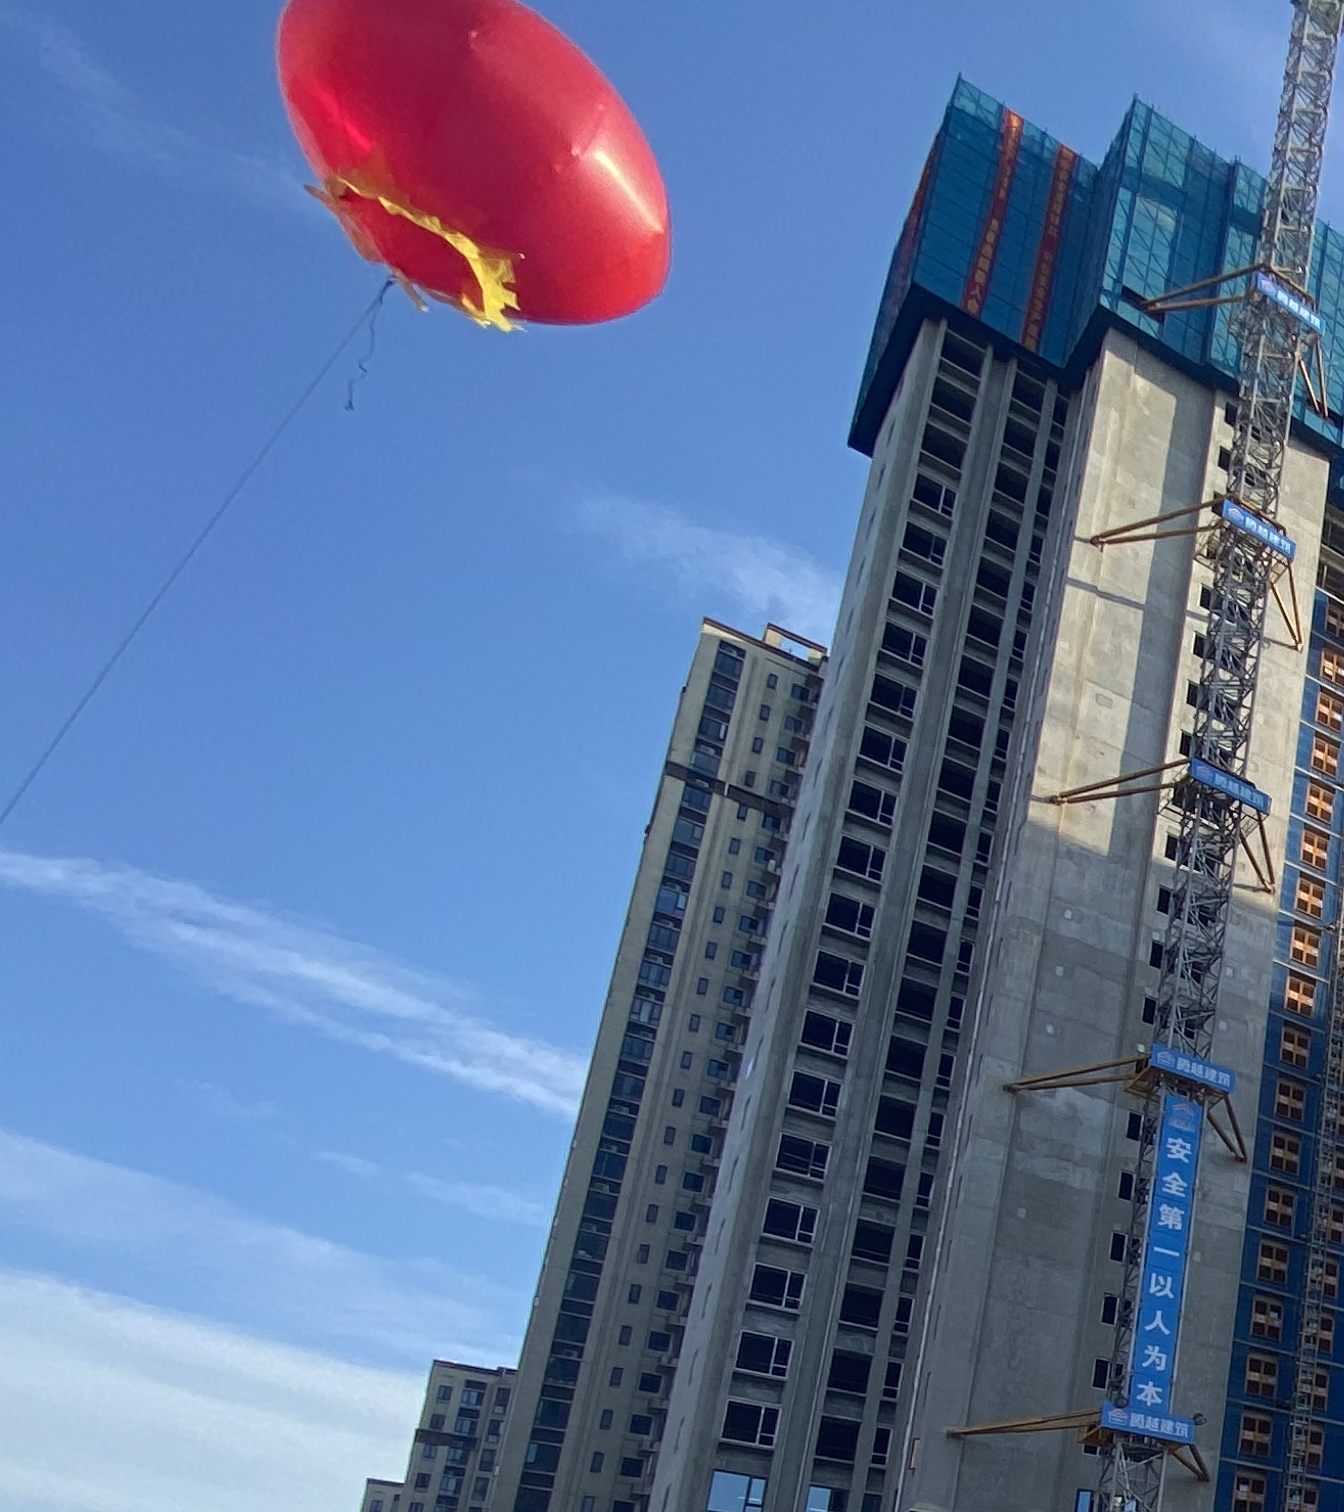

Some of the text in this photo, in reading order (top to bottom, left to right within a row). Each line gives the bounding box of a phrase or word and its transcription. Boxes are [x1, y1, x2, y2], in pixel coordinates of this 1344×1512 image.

[1136, 1136, 1193, 1407] 安全第一以人为本
